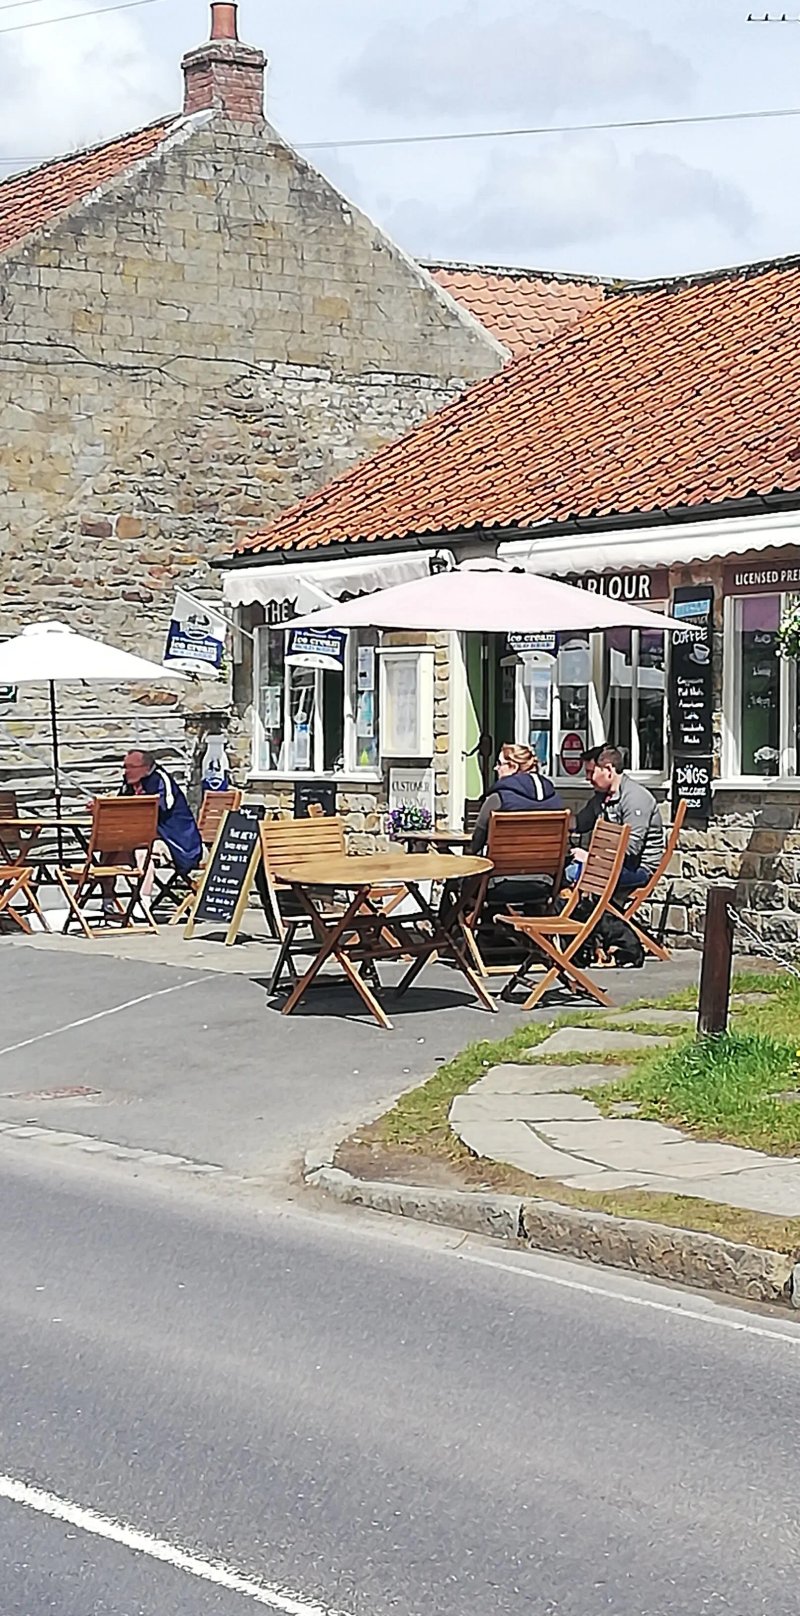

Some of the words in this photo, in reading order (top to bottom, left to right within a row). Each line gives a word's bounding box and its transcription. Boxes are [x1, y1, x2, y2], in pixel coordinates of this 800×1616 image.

[567, 574, 651, 600] RLOUR
[735, 571, 779, 586] LICENSED
[780, 569, 800, 582] PRE
[263, 602, 290, 623] THE
